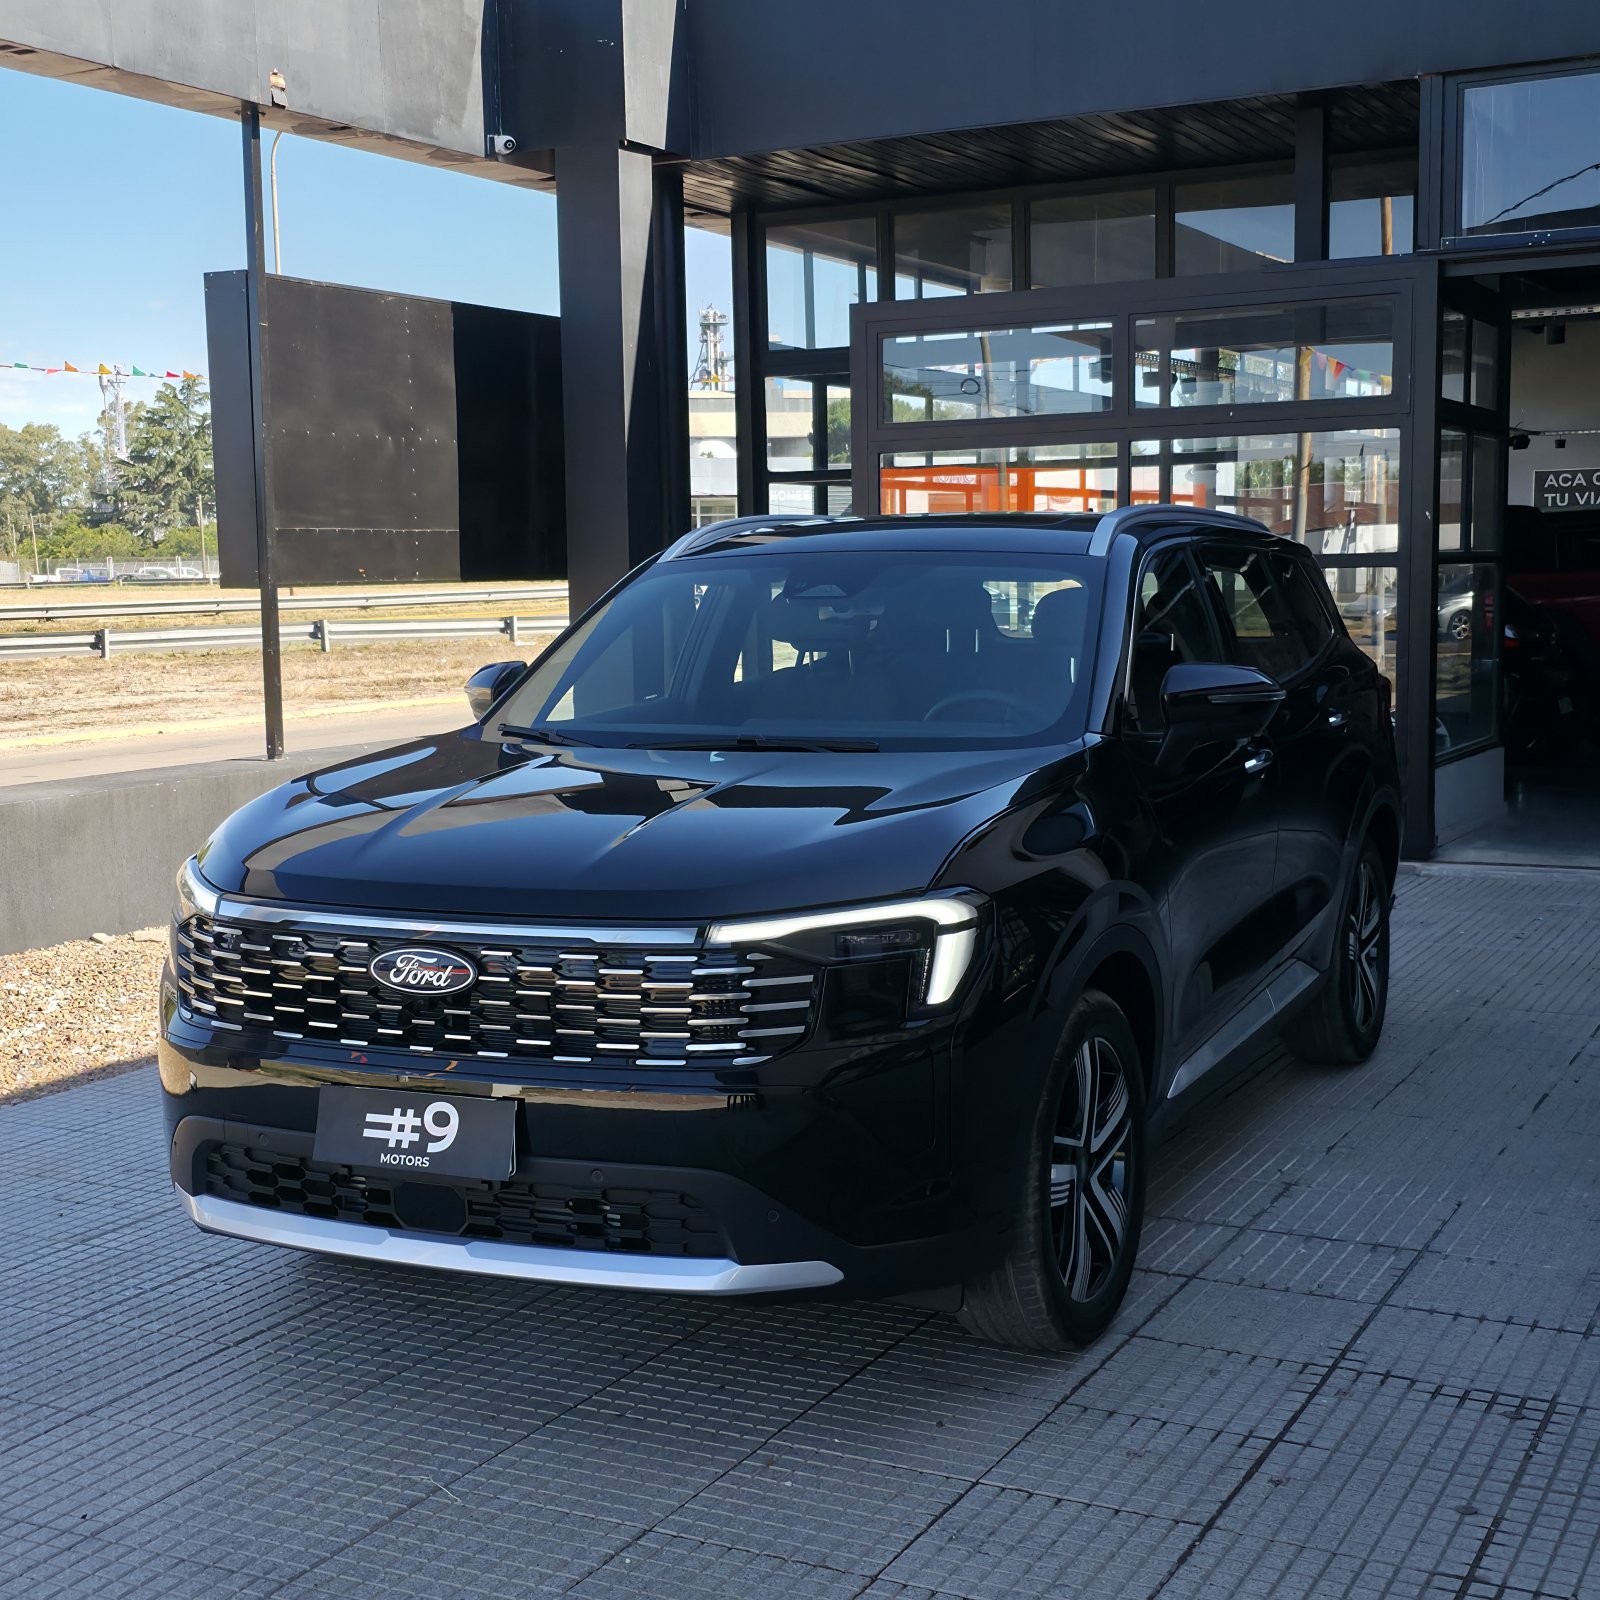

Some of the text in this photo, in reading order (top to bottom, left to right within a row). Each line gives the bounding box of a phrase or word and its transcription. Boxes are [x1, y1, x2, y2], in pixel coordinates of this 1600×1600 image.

[1544, 472, 1587, 488] ACA
[1543, 493, 1569, 507] TU
[390, 954, 453, 987] Ford
[380, 1152, 430, 1168] MOTORS
